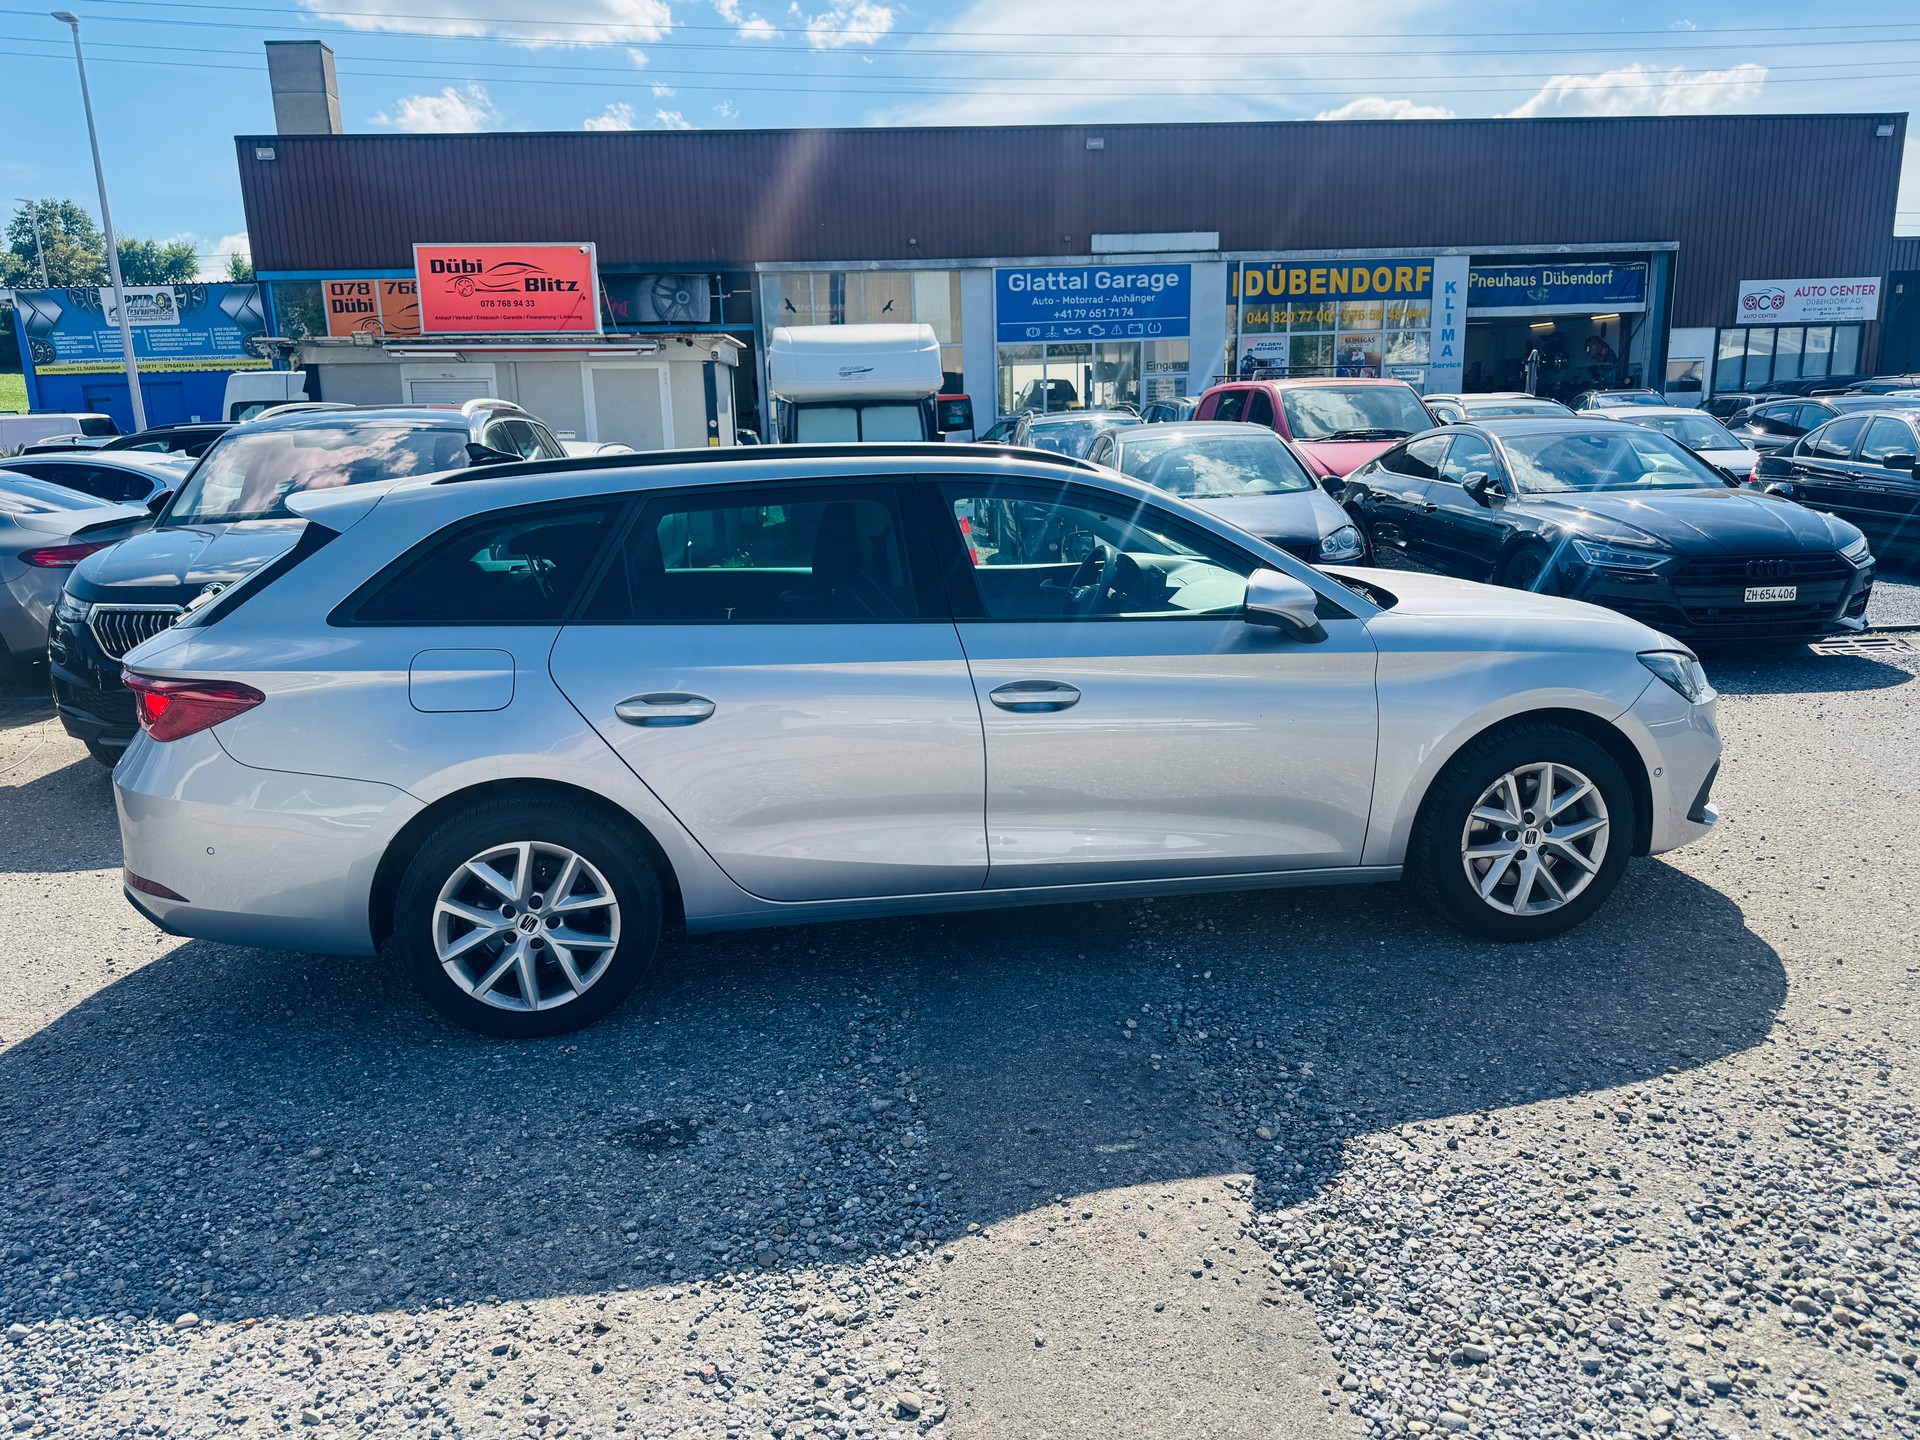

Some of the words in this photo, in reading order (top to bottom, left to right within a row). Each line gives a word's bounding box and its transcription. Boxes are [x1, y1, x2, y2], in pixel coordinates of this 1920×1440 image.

[430, 259, 483, 274] Dübi
[525, 277, 580, 292] Blitz
[1008, 272, 1088, 292] Glattal
[1094, 271, 1180, 292] Garage
[1245, 263, 1431, 297] DÜBENDORF
[1469, 272, 1537, 289] Pneuhaus
[1542, 269, 1614, 286] Dübendorf
[331, 282, 371, 296] 078
[1793, 285, 1827, 298] AUTO
[1829, 284, 1876, 297] CENTER
[331, 298, 374, 313] Dübi
[480, 299, 496, 308] 078
[497, 299, 512, 308] 768
[513, 299, 525, 308] 94
[525, 299, 536, 308] 33
[1032, 296, 1054, 306] Auto
[1062, 295, 1104, 305] Motorrad
[1111, 294, 1156, 304] Anhänger
[1805, 298, 1848, 306] DÜBENDORF
[1849, 297, 1862, 305] AG
[526, 314, 557, 322] Finanzierung
[560, 313, 583, 321] Lieferung
[1053, 309, 1073, 319] +41
[1074, 309, 1087, 319] 79
[1088, 308, 1108, 318] 651
[1121, 307, 1135, 317] 74
[1246, 310, 1269, 325] 044
[1272, 310, 1295, 324] 820
[1298, 310, 1313, 323] 77
[1316, 310, 1333, 323] 00
[1440, 280, 1457, 358] KLIMA
[1145, 360, 1188, 373] Eingang
[1431, 361, 1462, 369] Service
[1778, 588, 1795, 600] 406
